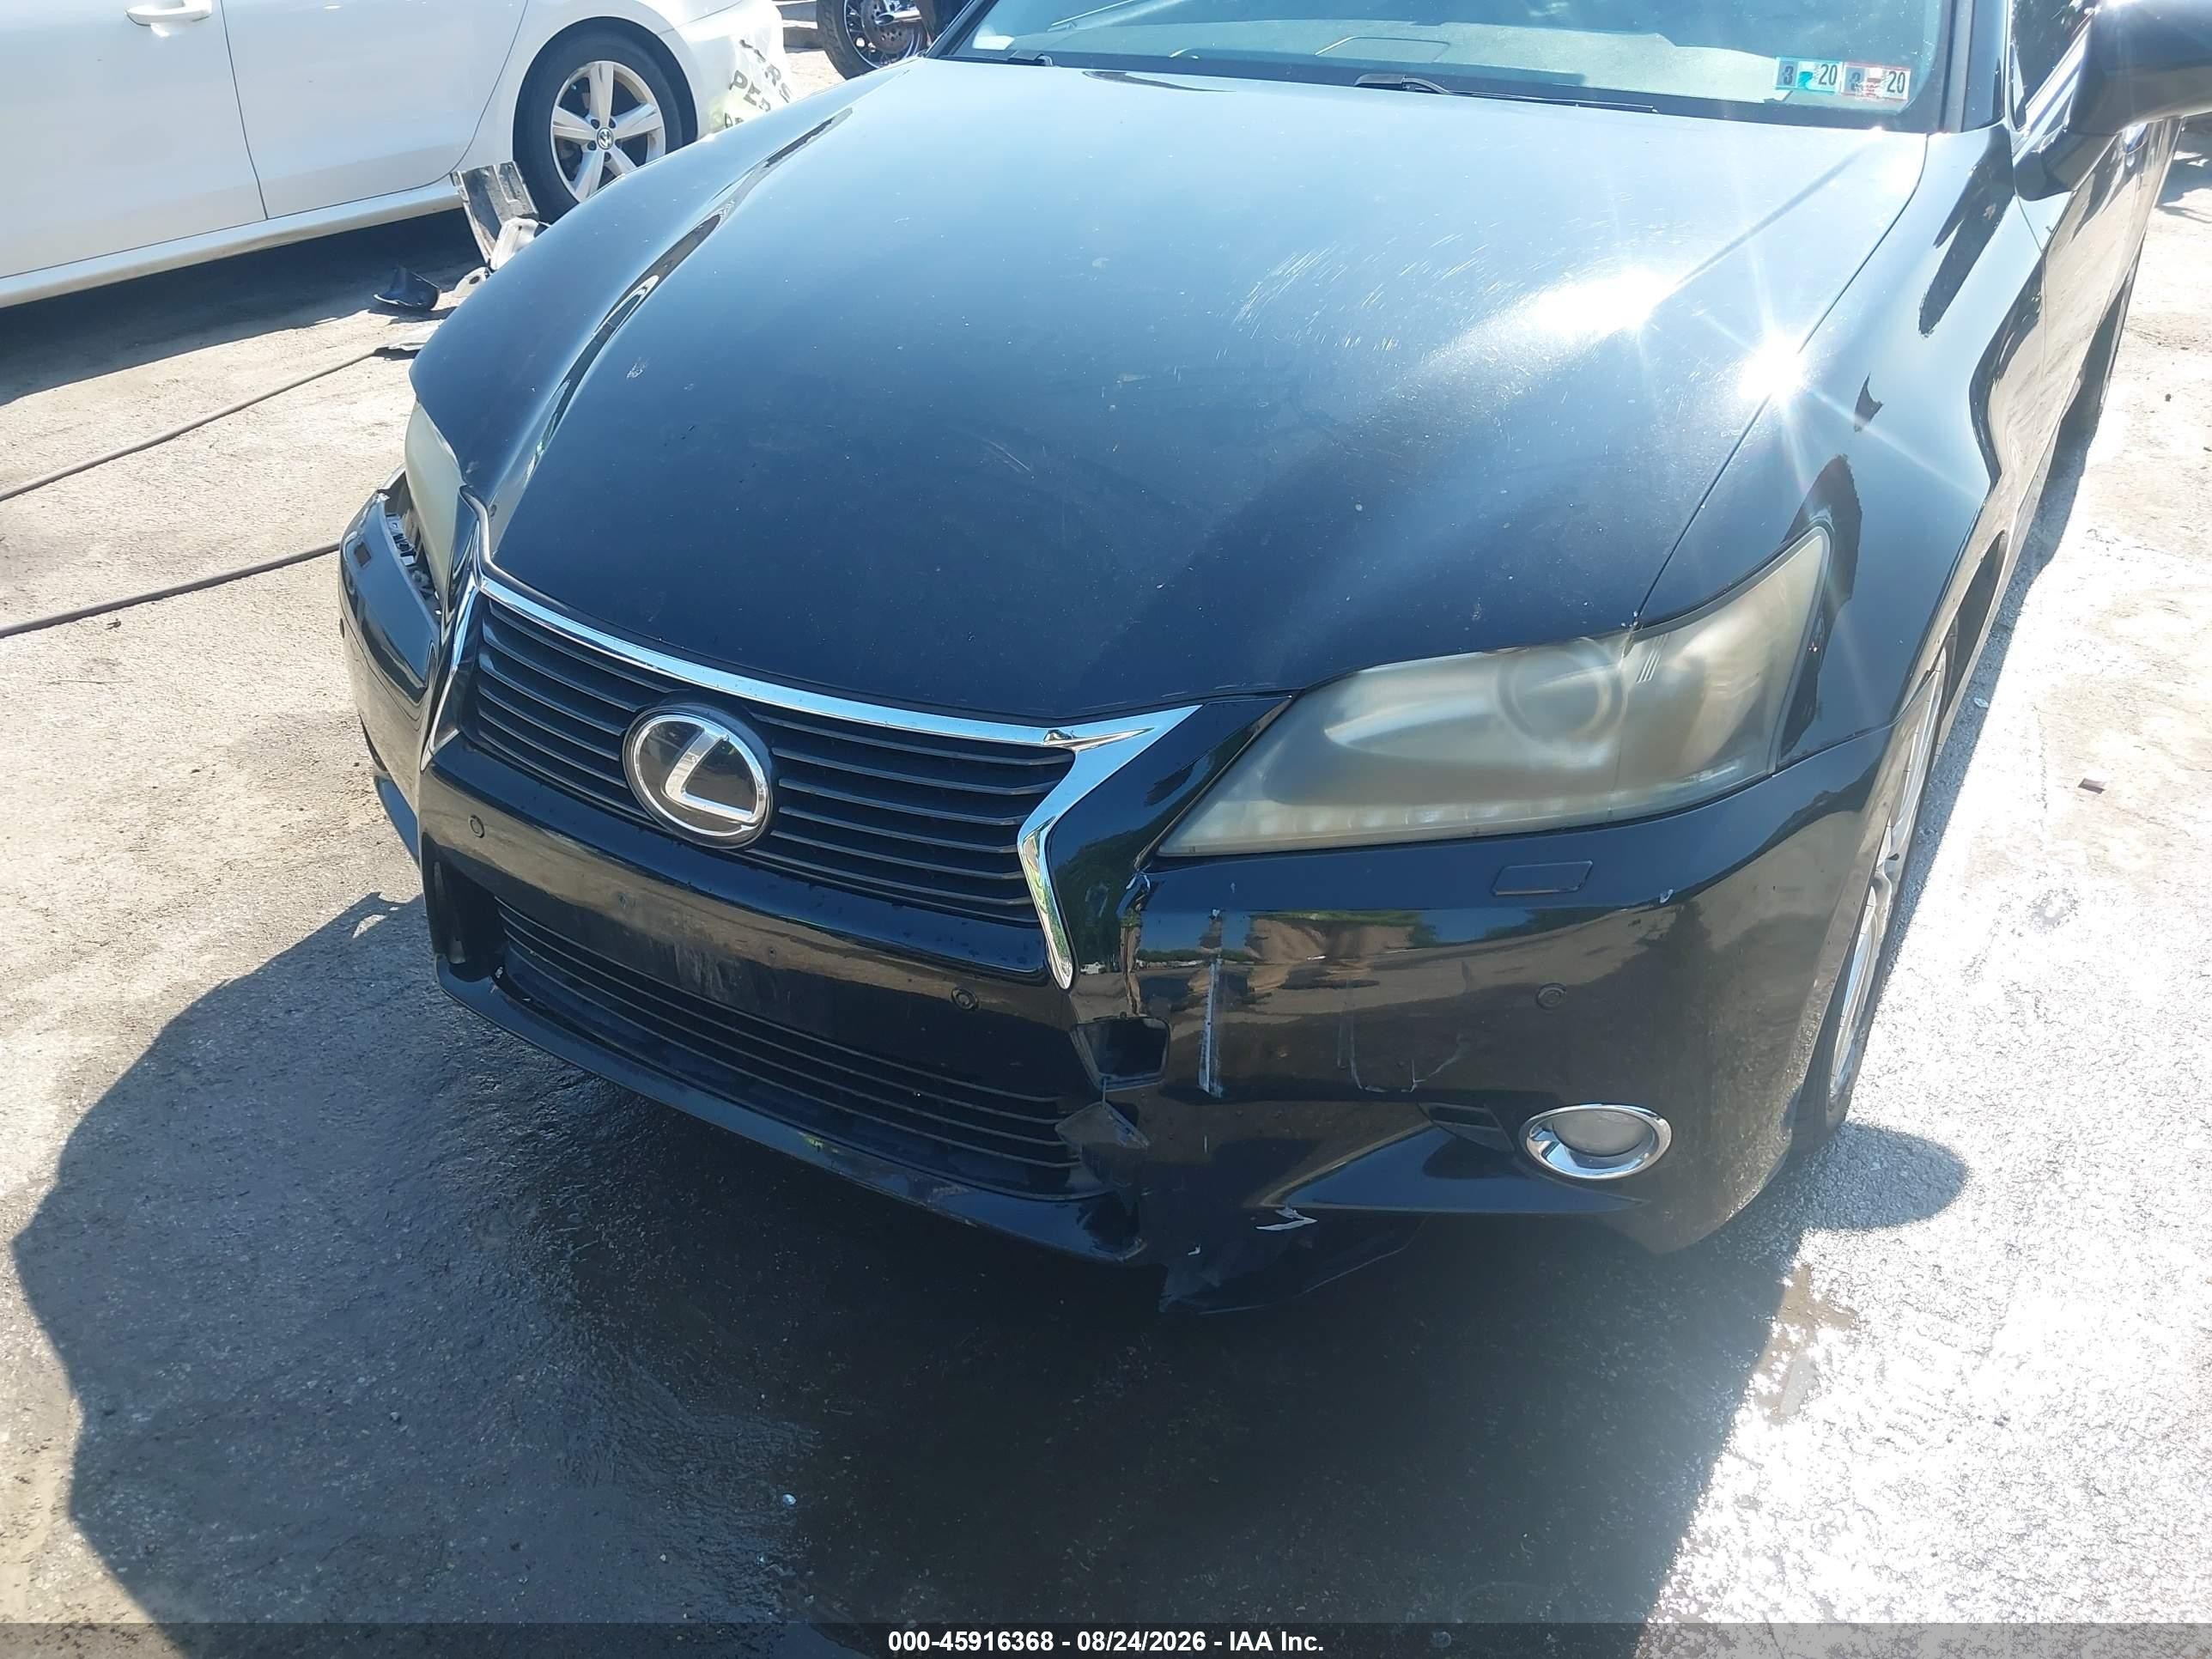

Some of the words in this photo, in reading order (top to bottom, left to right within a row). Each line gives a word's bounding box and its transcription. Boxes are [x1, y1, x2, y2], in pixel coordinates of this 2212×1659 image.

[1783, 65, 1794, 86] 3
[1818, 64, 1838, 86] 20
[1887, 70, 1905, 94] 20
